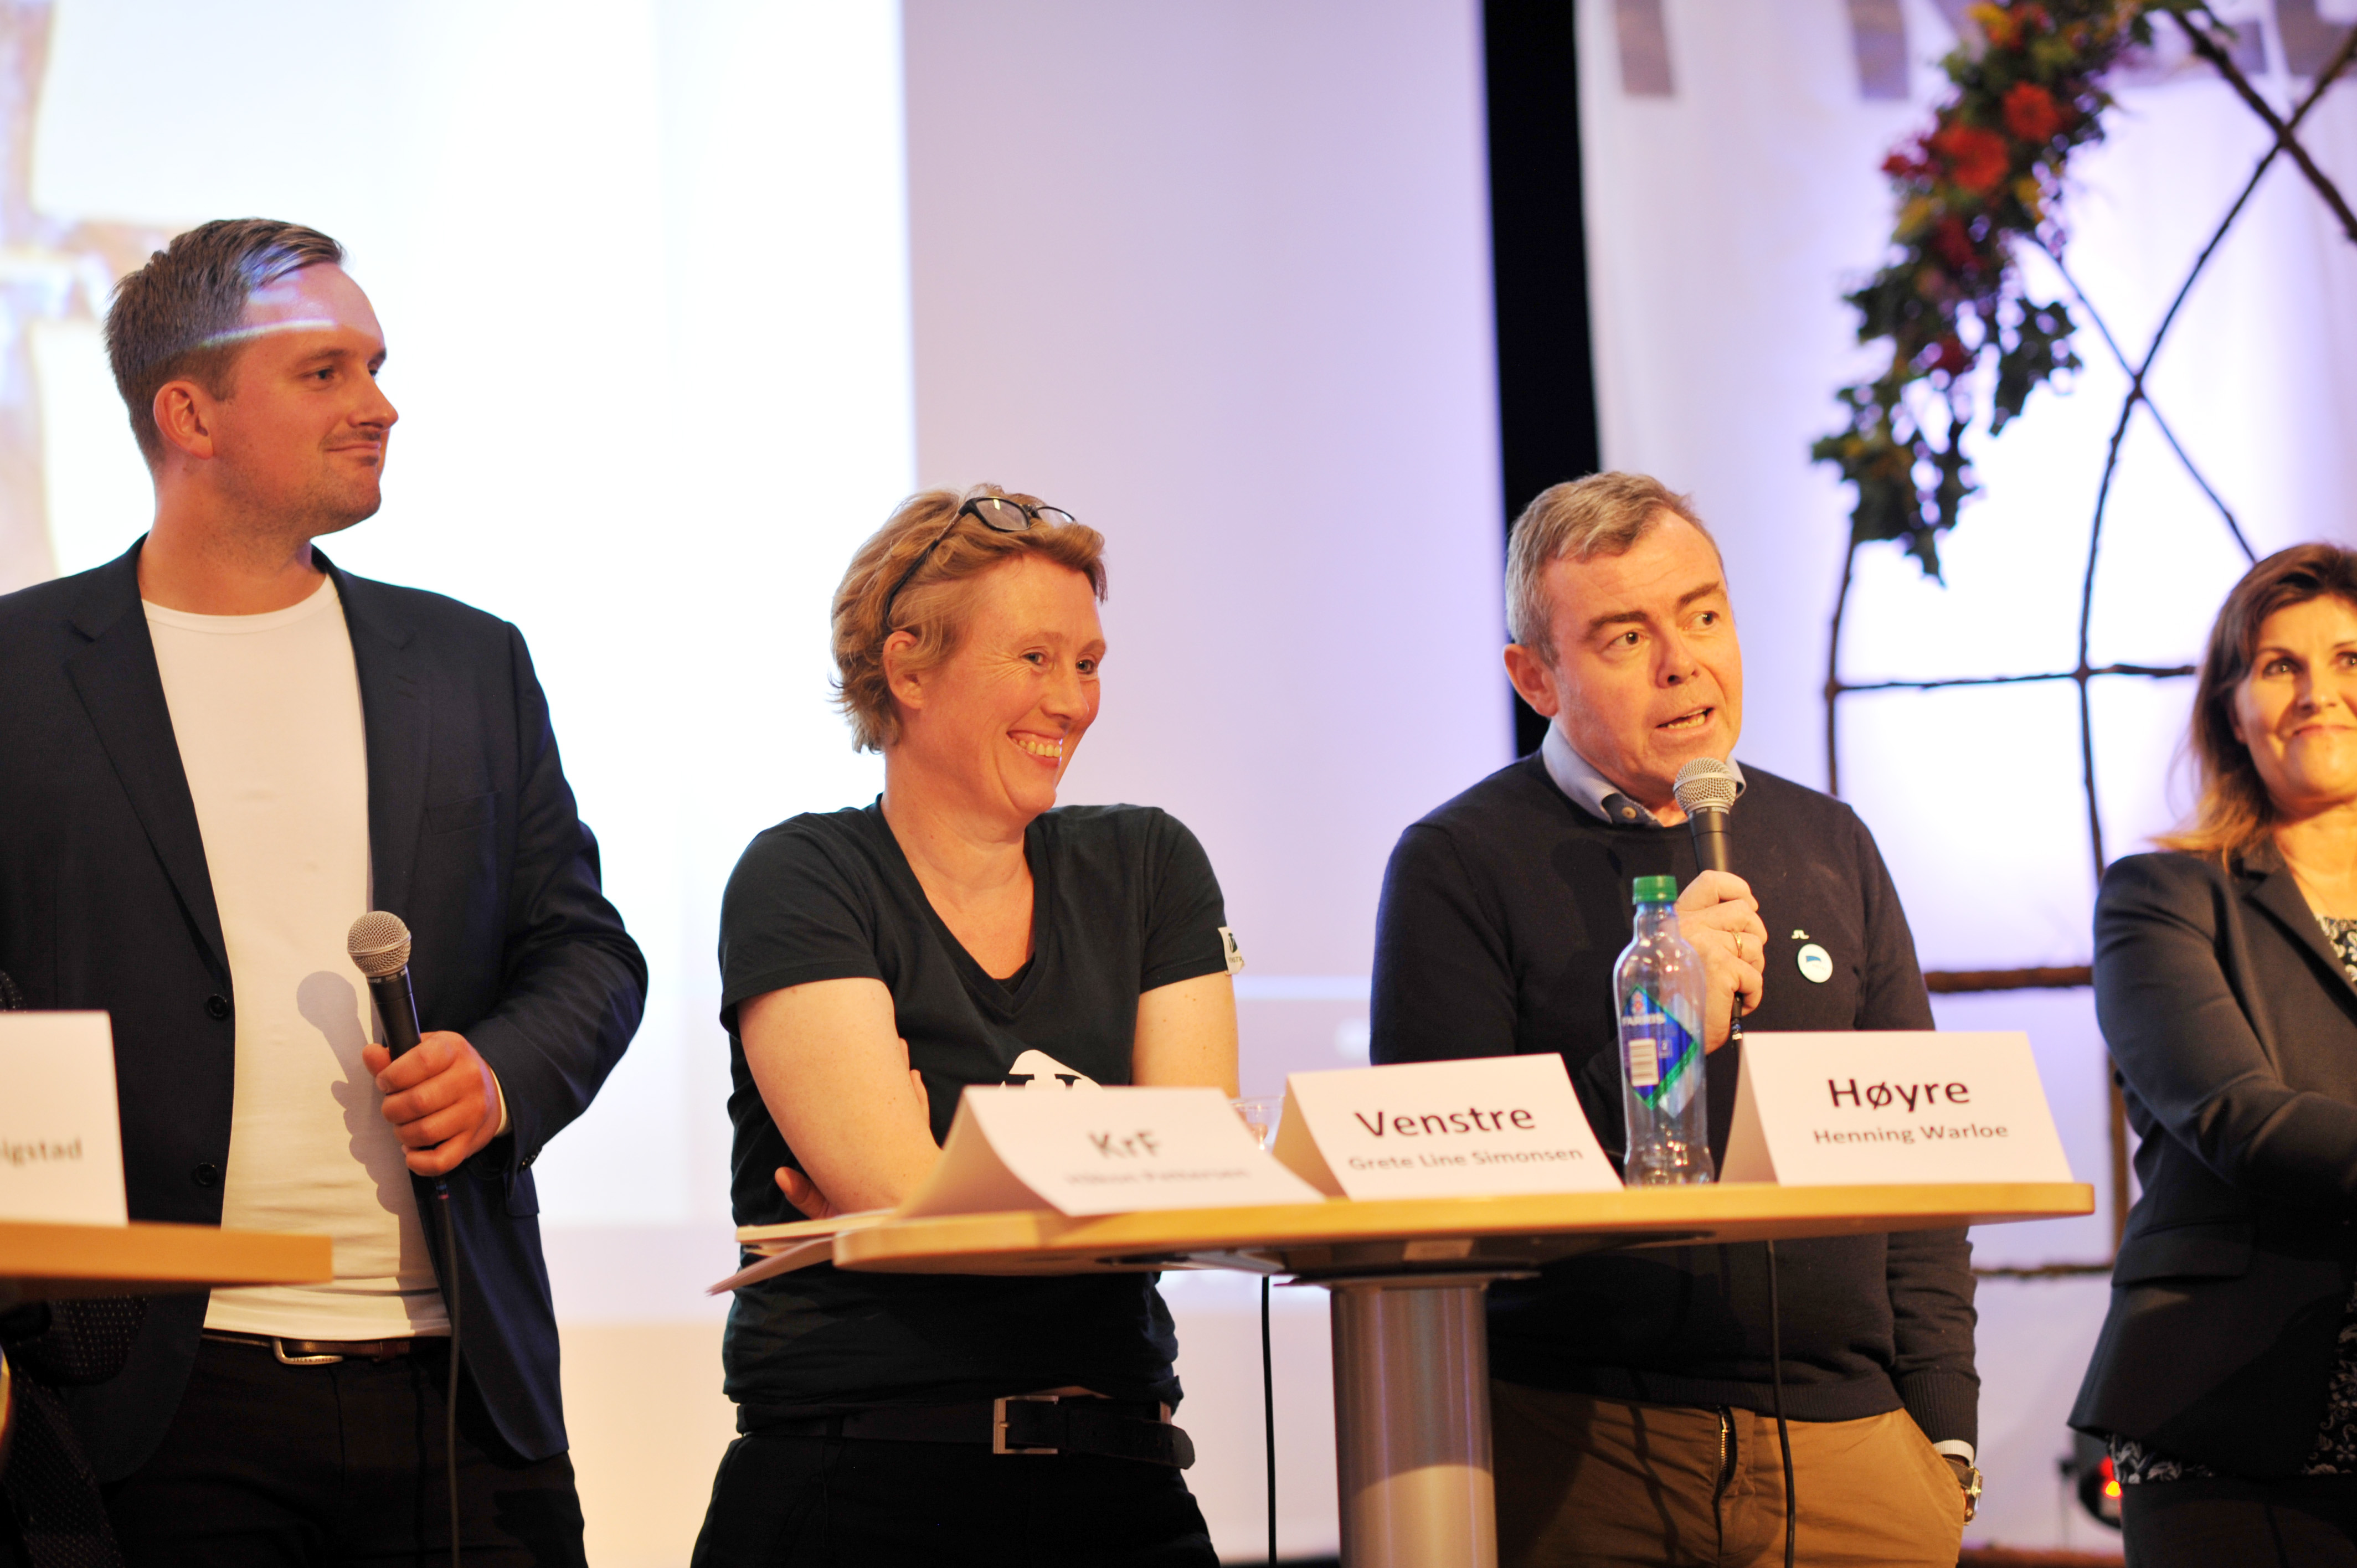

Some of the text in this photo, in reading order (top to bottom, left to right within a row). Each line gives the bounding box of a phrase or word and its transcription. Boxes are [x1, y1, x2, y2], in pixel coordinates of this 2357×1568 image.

[1828, 1079, 1970, 1113] Høyre
[1354, 1107, 1535, 1137] Venstre
[1813, 1123, 2008, 1144] Henning Warloe
[0, 1138, 83, 1167] igstad
[1087, 1131, 1161, 1158] KrF
[1348, 1149, 1584, 1170] Grete Line Simonsen
